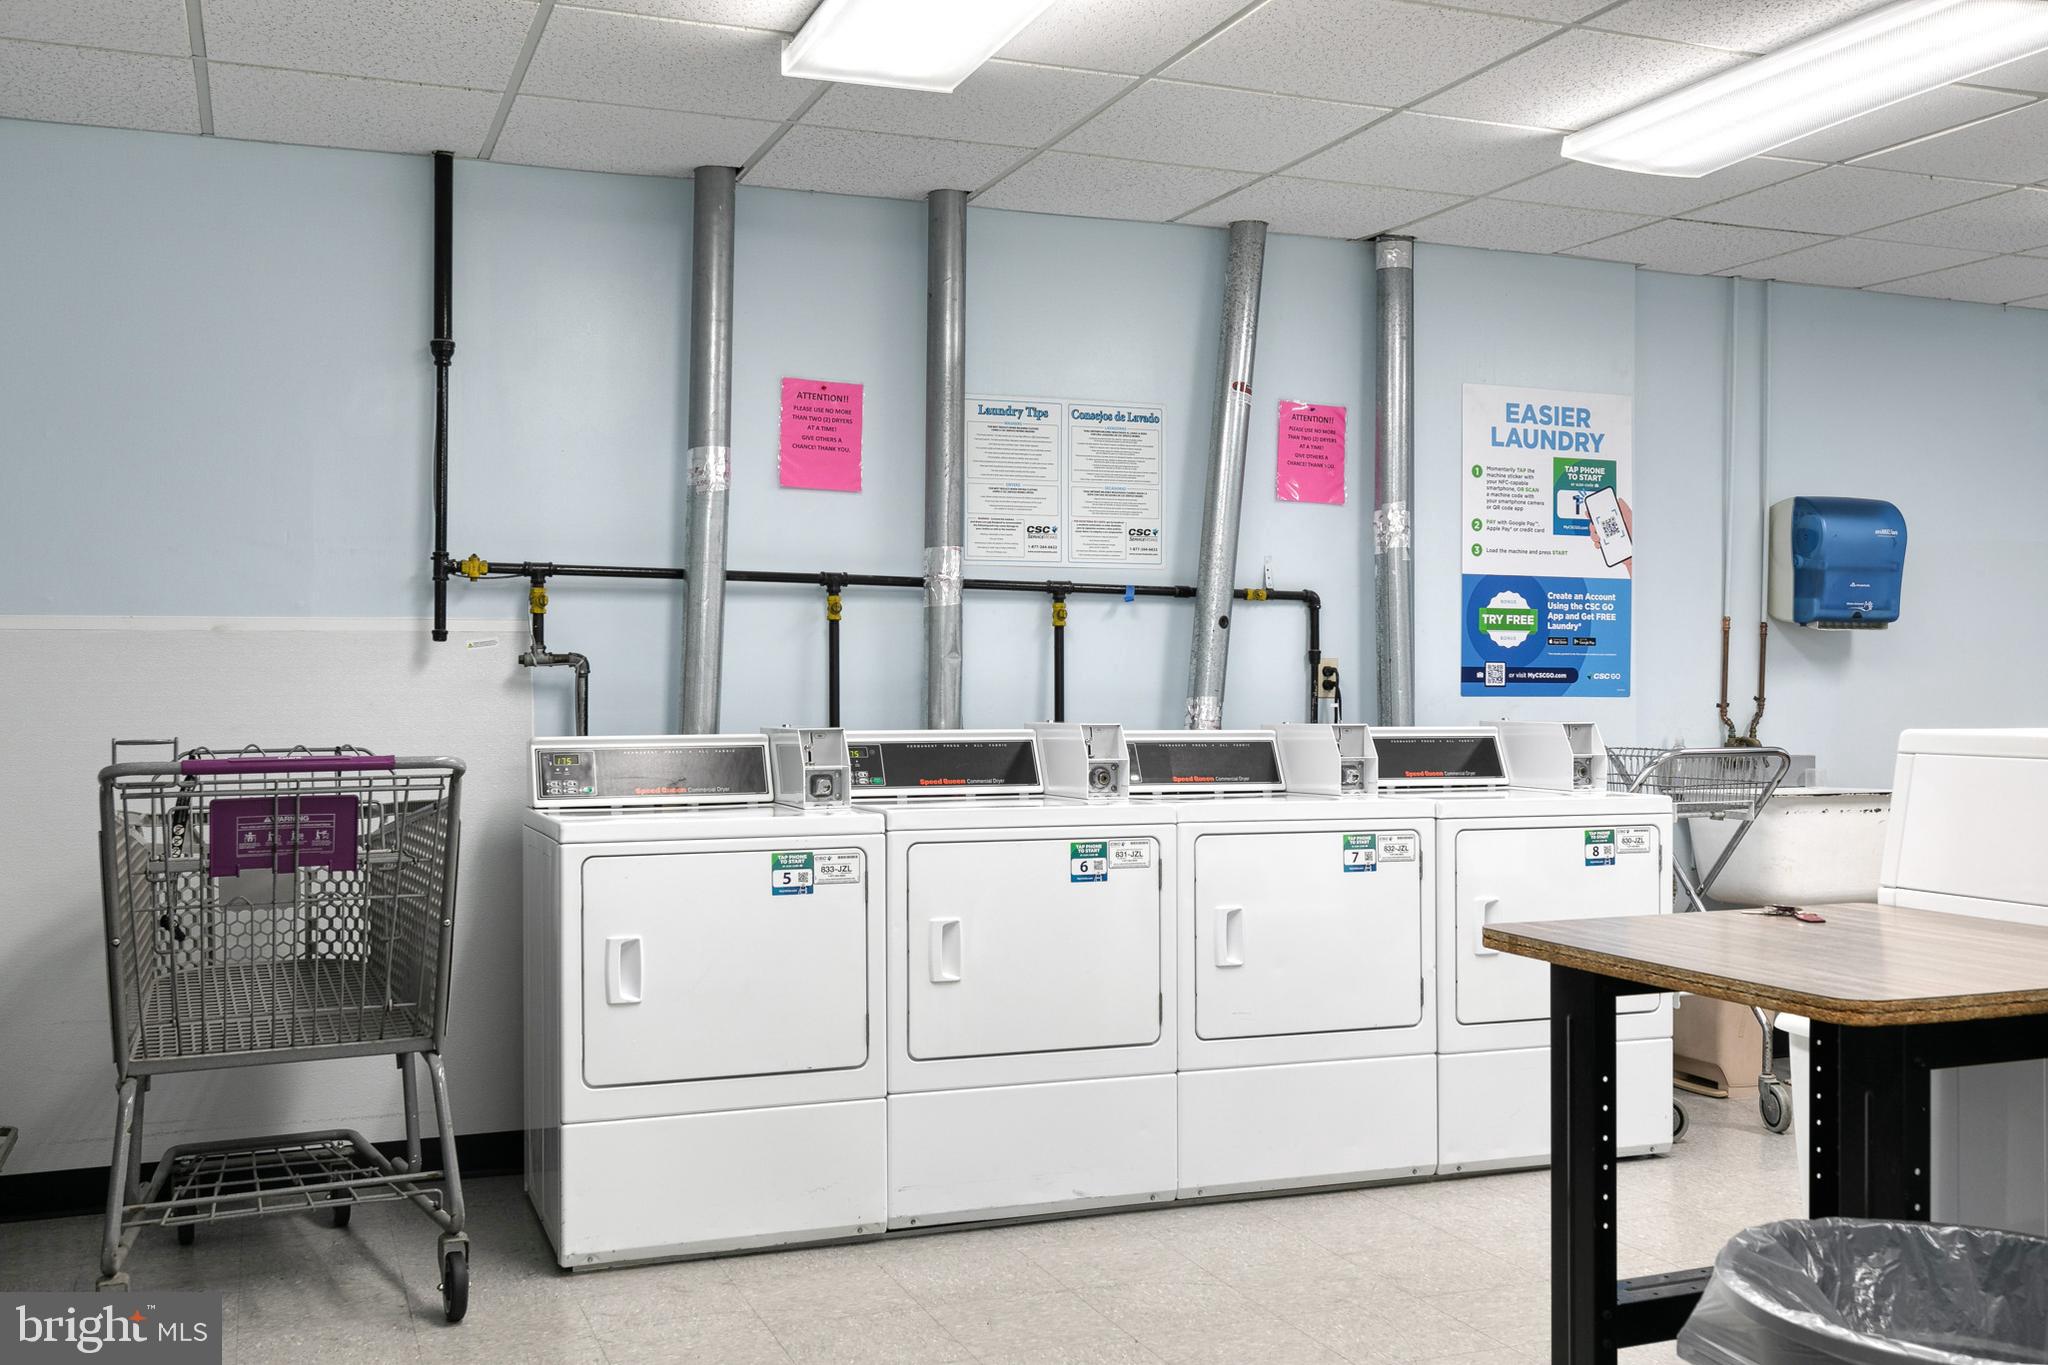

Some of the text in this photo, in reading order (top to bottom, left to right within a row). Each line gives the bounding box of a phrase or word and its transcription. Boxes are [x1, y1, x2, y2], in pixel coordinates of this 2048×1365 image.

[797, 392, 848, 403] ATTENTION!!
[978, 404, 1049, 421] Laundry Tips
[1071, 408, 1160, 424] Consejos de Lavado
[1506, 403, 1591, 428] EASIER
[1292, 414, 1334, 424] ATTENTION!!
[815, 435, 837, 443] OTHERS
[1491, 426, 1605, 453] LAUNDRY
[1564, 465, 1579, 473] TAP
[1027, 525, 1051, 534] CSC
[1129, 528, 1151, 536] CSC
[1547, 592, 1573, 600] Create
[1585, 593, 1616, 601] Account
[1547, 602, 1614, 611] Using the CSC GO
[1482, 614, 1535, 625] TRY FREE
[1547, 613, 1563, 621] App
[1565, 612, 1580, 620] and
[920, 778, 942, 786] Speed
[1593, 846, 1599, 857] 8
[1352, 852, 1359, 863] 7
[821, 865, 852, 873] 833-JZL
[1080, 861, 1088, 872] 6
[783, 872, 791, 885] 5
